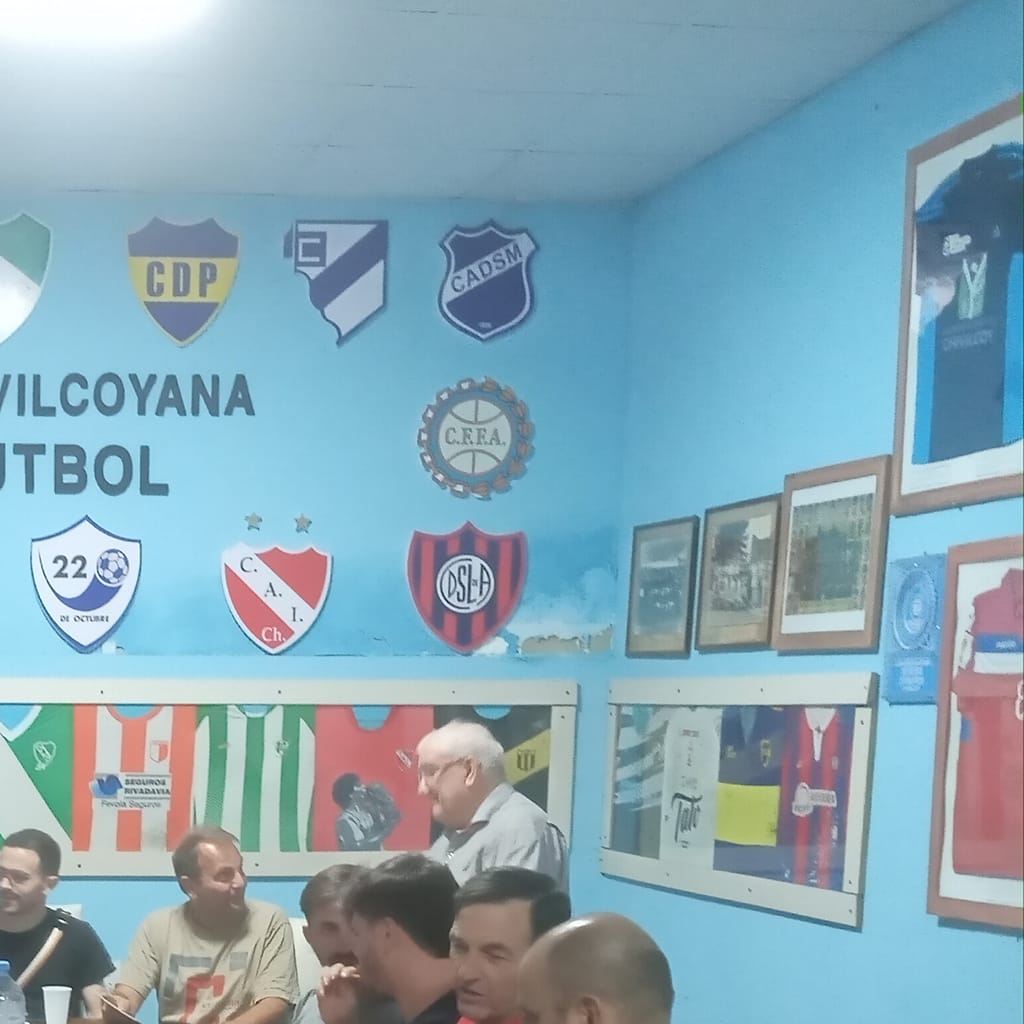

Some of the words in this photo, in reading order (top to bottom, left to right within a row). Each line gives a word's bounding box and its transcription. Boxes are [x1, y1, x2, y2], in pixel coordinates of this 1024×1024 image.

[451, 243, 523, 293] CADSM
[52, 554, 88, 579] 22
[60, 615, 70, 623] DE
[73, 615, 110, 623] OCTUBRE
[124, 787, 172, 795] RIVADAVIA
